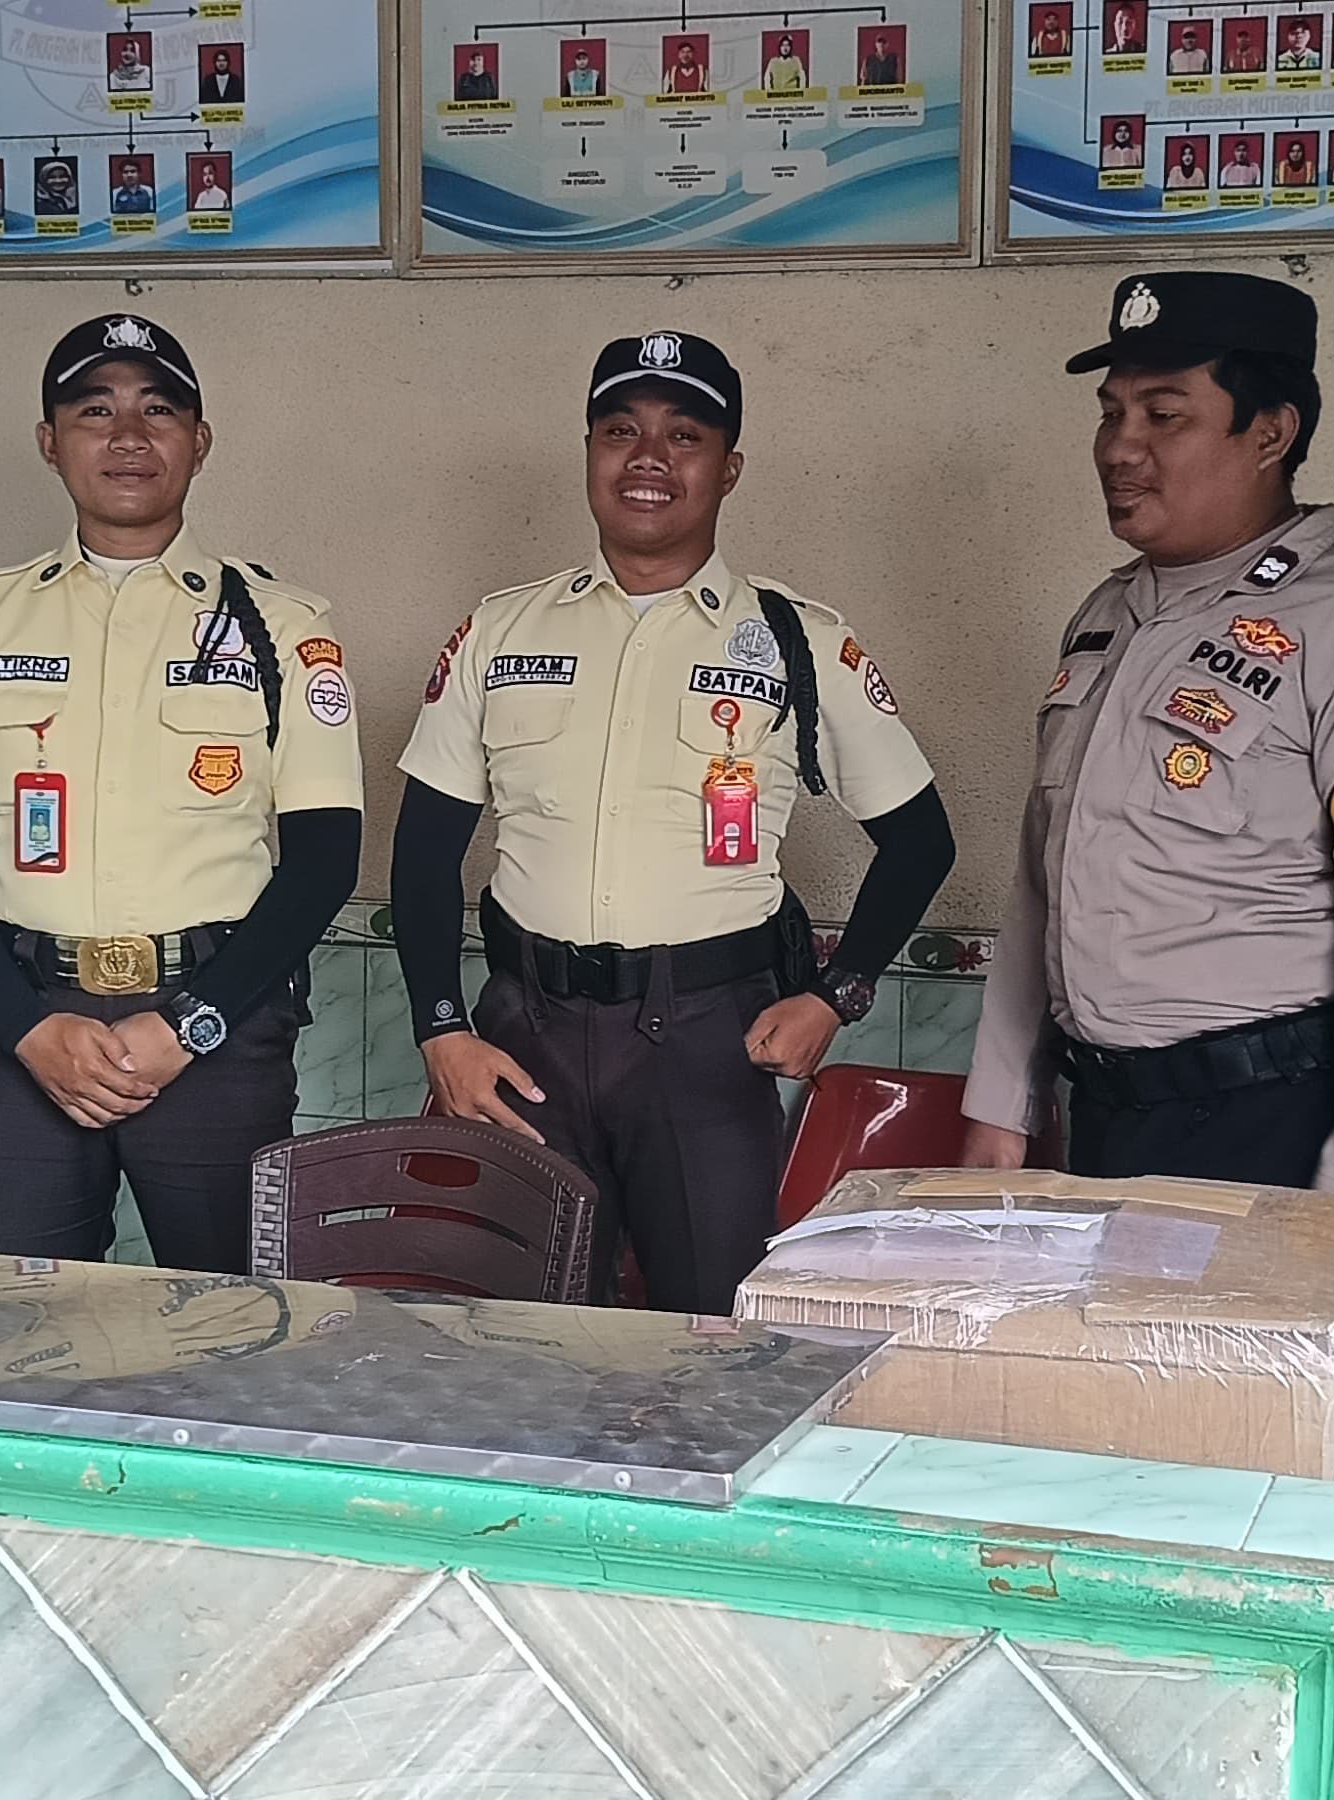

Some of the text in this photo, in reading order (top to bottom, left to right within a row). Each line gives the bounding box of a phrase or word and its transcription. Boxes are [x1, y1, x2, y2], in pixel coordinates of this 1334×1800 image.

[173, 662, 254, 687] SPAM
[495, 657, 563, 674] HISYAM
[1188, 639, 1282, 701] POLRI
[311, 689, 348, 709] G2S
[698, 670, 784, 704] SATPAM
